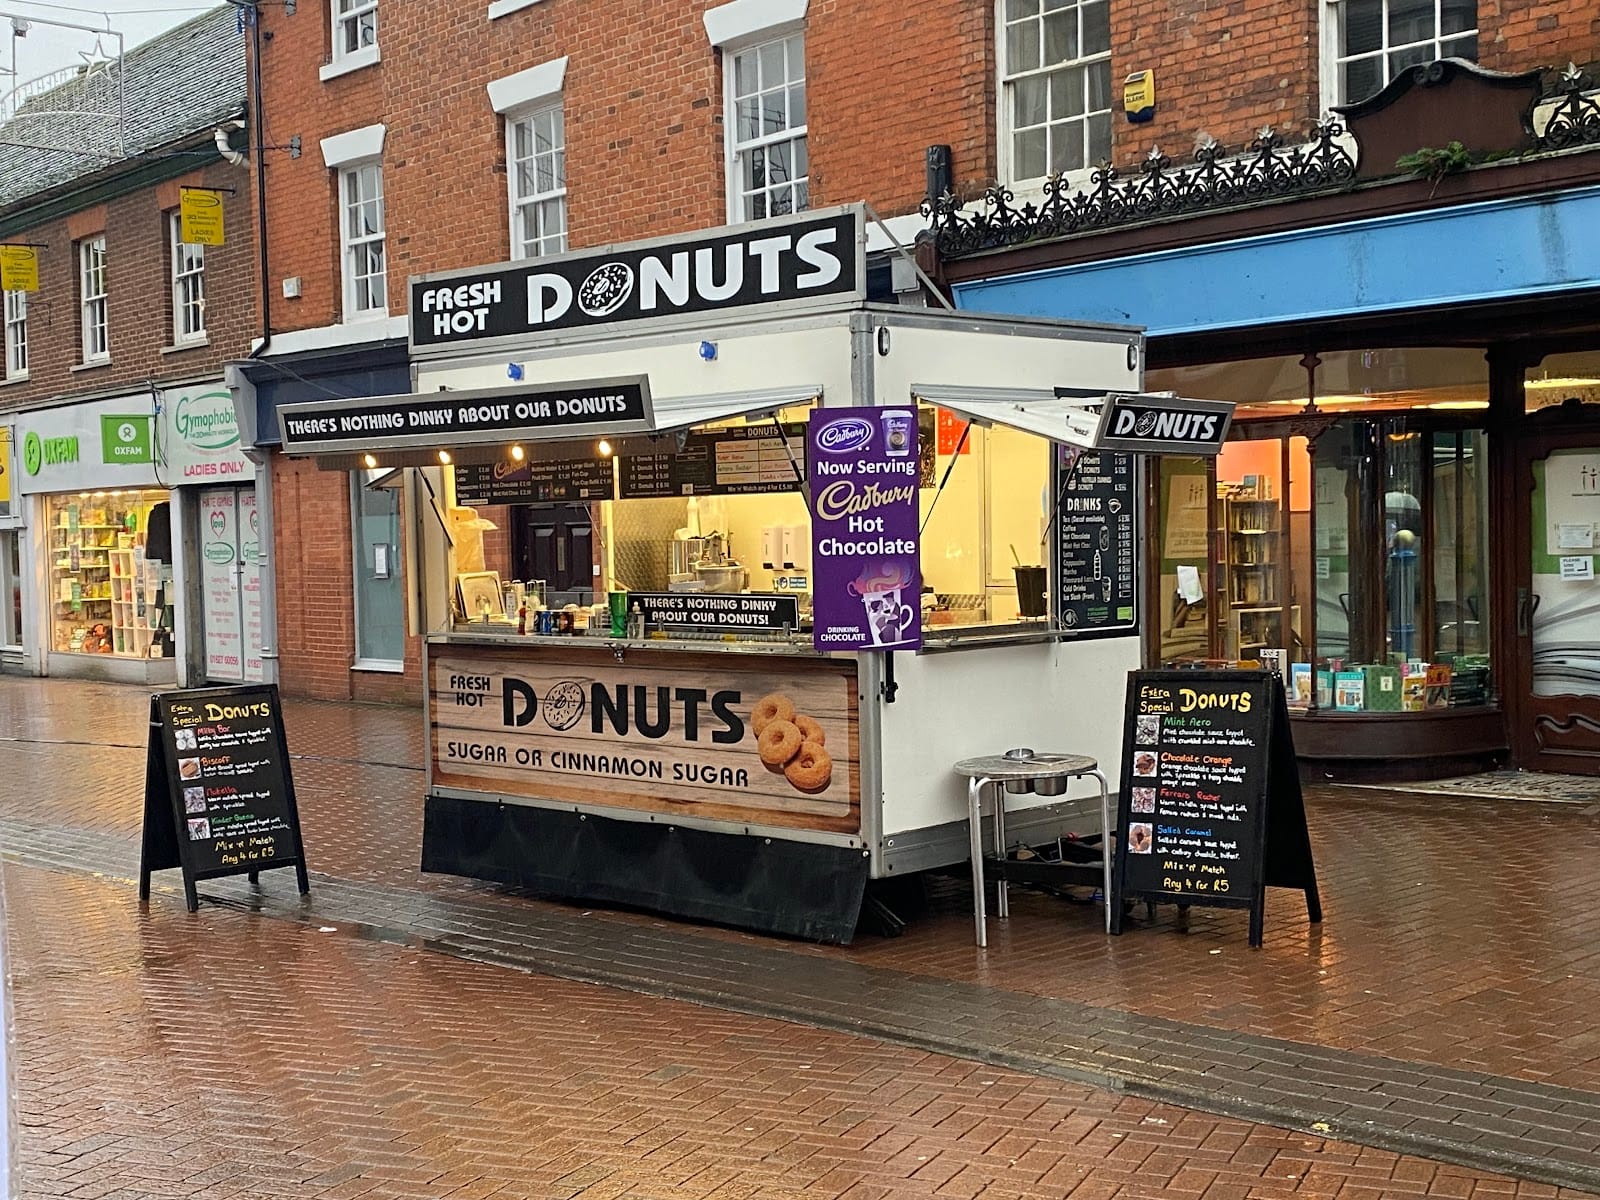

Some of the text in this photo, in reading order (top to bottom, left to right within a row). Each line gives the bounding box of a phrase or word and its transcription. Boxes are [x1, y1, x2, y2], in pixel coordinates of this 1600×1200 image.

[527, 227, 841, 325] DONUTS
[423, 280, 501, 312] FRESH
[433, 308, 488, 336] HOT
[288, 395, 627, 436] THERE'S NOTHING DINKY ABOUT OUR DONUTS
[747, 427, 779, 437] DONUTS
[1114, 409, 1218, 440] DONUTS
[822, 427, 865, 447] Cadbury
[43, 436, 79, 465] OXFAM
[114, 446, 143, 456] OXFAM
[184, 461, 245, 477] LADIES ONLY
[817, 459, 915, 476] Now Serving
[817, 480, 914, 520] Cadbury
[1067, 498, 1101, 511] DRINKS
[849, 516, 884, 532] Hot
[818, 537, 915, 556] Chocolate
[643, 598, 777, 611] THERE'S NOTHING DINKY
[652, 611, 769, 625] ABOUT OUR DONUTS!
[820, 633, 866, 641] CHOCOLATE
[450, 675, 491, 691] FRESH
[1140, 686, 1170, 697] Extra
[456, 692, 485, 707] HOT
[1140, 701, 1174, 713] Special
[171, 704, 193, 713] Extra
[502, 678, 745, 744] DONUTS
[173, 715, 202, 725] Special
[1164, 717, 1212, 726] Mint Aero
[216, 724, 230, 733] Bar
[447, 742, 749, 787] SUGAR OR CINNAMON SUGAR
[1161, 752, 1233, 767] Chocolate Orange
[1157, 825, 1181, 834] Salted
[215, 841, 234, 852] Mix
[249, 836, 275, 846] Match
[221, 854, 239, 865] Any
[240, 851, 247, 860] 4
[248, 851, 258, 859] for
[1163, 861, 1184, 870] Mix
[1201, 865, 1226, 874] Match
[1163, 877, 1182, 892] Any
[1186, 879, 1192, 889] 4
[1196, 880, 1208, 890] for
